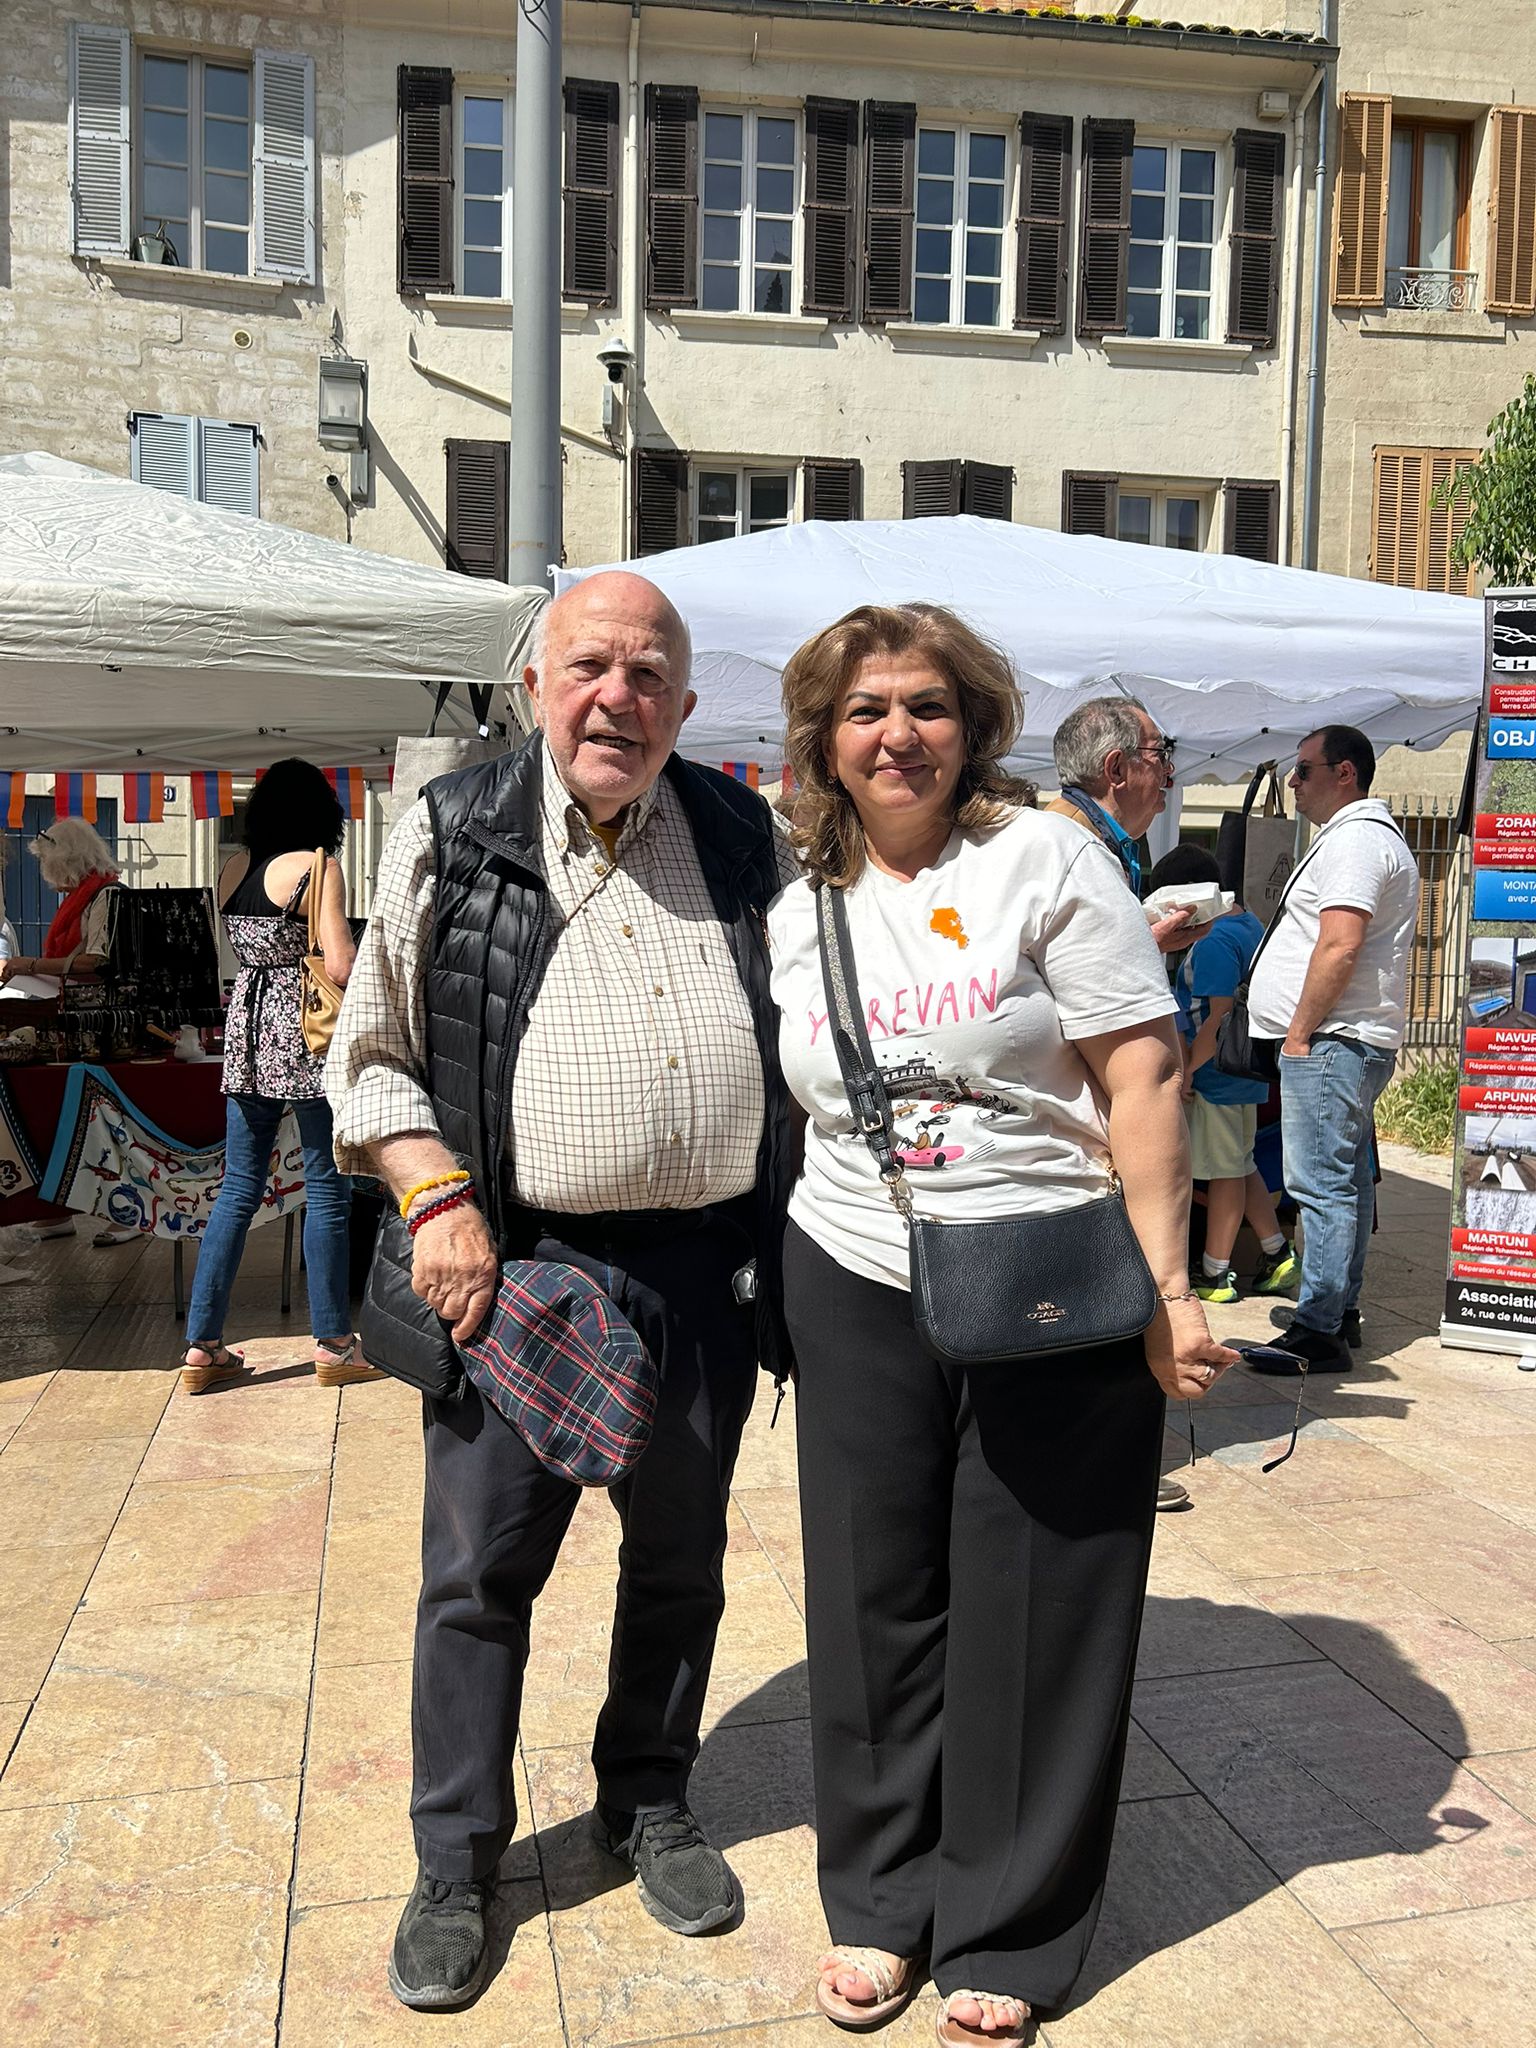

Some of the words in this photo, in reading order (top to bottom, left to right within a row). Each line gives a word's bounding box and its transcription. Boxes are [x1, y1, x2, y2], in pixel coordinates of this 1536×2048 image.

[1494, 688, 1535, 696] Construction
[1500, 696, 1535, 704] permettant
[1502, 702, 1521, 710] terres
[1493, 730, 1535, 747] OBJ
[1498, 830, 1520, 838] Région
[1508, 845, 1527, 853] place
[1508, 895, 1529, 903] avec
[808, 968, 998, 1046] YREVAN
[1488, 1044, 1510, 1052] Région
[1469, 1062, 1506, 1071] Réparation
[1507, 1063, 1516, 1071] du
[1474, 1102, 1497, 1110] Région
[1468, 1231, 1529, 1248] MARTUNI
[1462, 1243, 1485, 1252] Région
[1458, 1264, 1495, 1274] Réparation
[1507, 1270, 1530, 1278] réseau
[1461, 1307, 1477, 1319] 24,
[1478, 1310, 1495, 1319] rue
[1497, 1311, 1511, 1321] de
[1513, 1313, 1536, 1324] Mau
